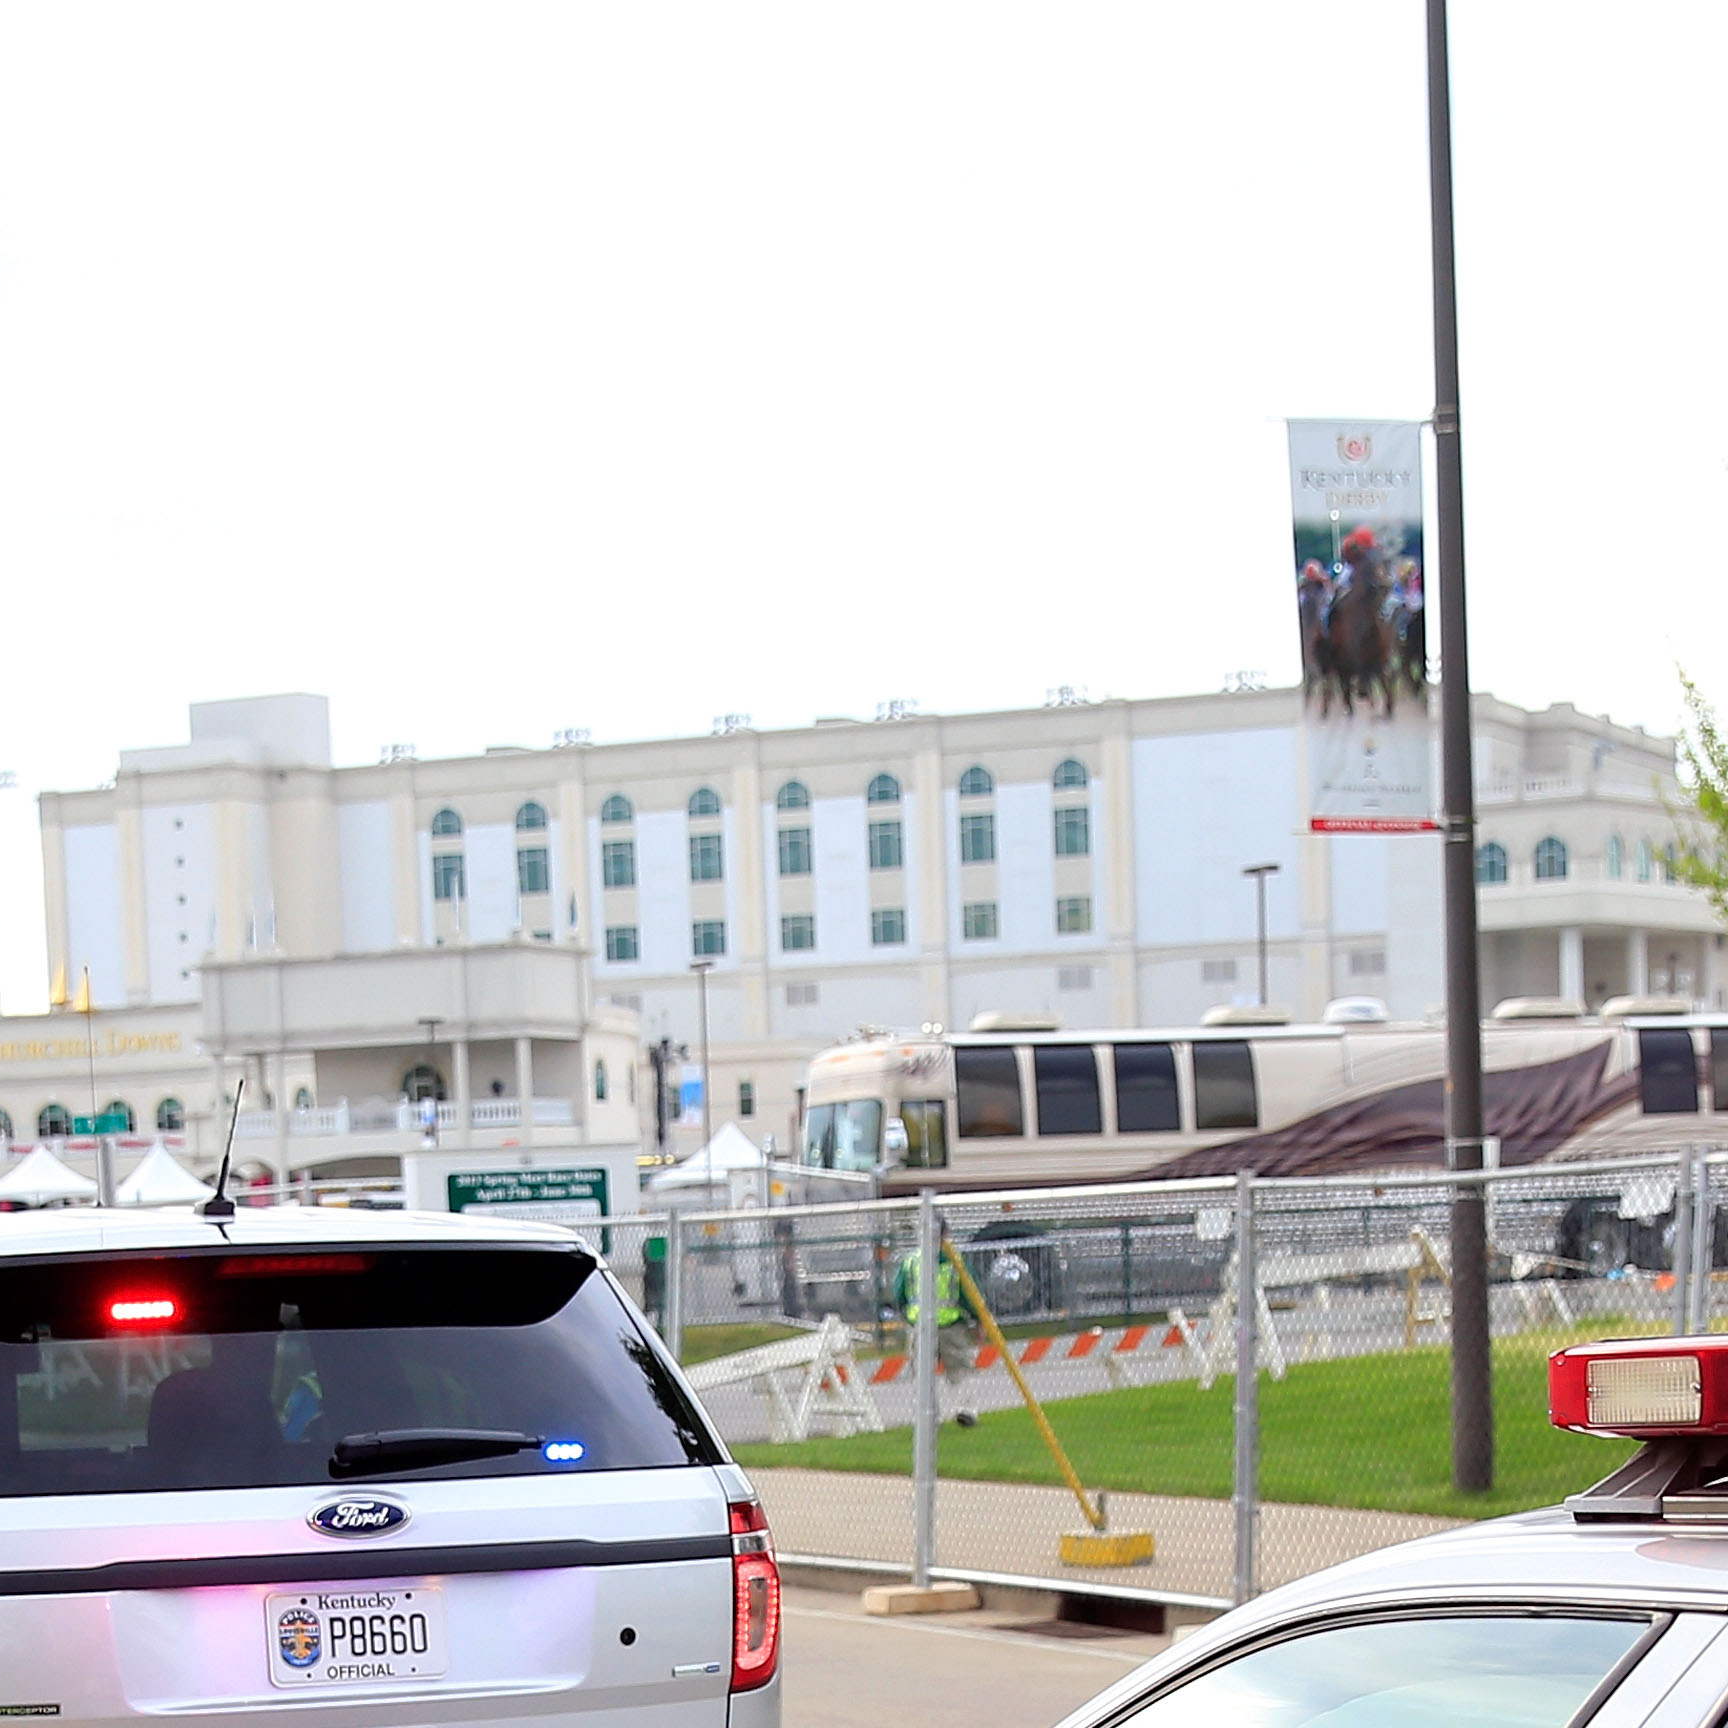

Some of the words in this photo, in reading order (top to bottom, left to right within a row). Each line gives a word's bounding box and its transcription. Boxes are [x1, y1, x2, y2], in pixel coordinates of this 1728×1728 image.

[332, 1502, 389, 1528] Ford
[318, 1592, 396, 1611] Kentucky
[329, 1613, 428, 1658] P8660
[327, 1663, 395, 1680] OFFICIAL
